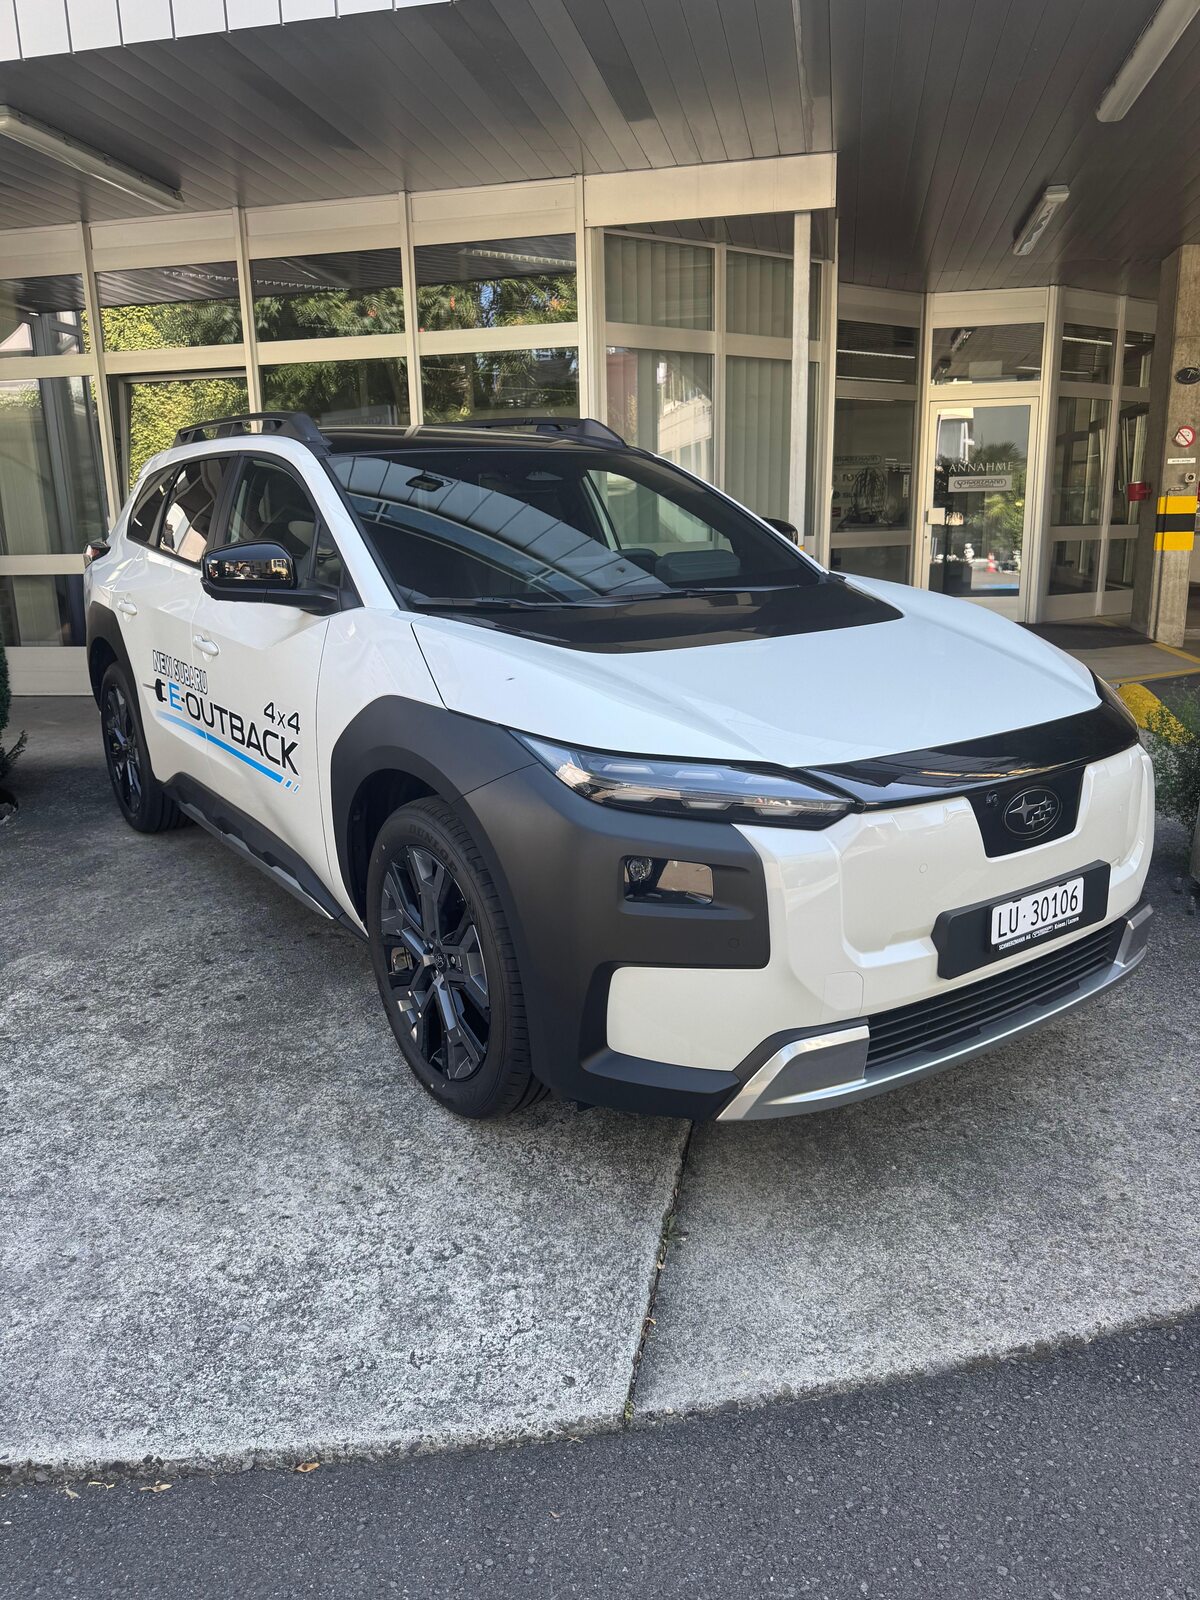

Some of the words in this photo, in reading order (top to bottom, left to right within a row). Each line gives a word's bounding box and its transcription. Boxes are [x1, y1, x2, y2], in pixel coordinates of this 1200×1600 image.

[949, 461, 1014, 473] ANNAHME
[152, 649, 173, 679] NEW
[172, 657, 208, 695] SUBARU
[168, 681, 300, 776] E-OUTBACK
[263, 701, 301, 735] 4x4
[409, 824, 458, 873] DUNLOP
